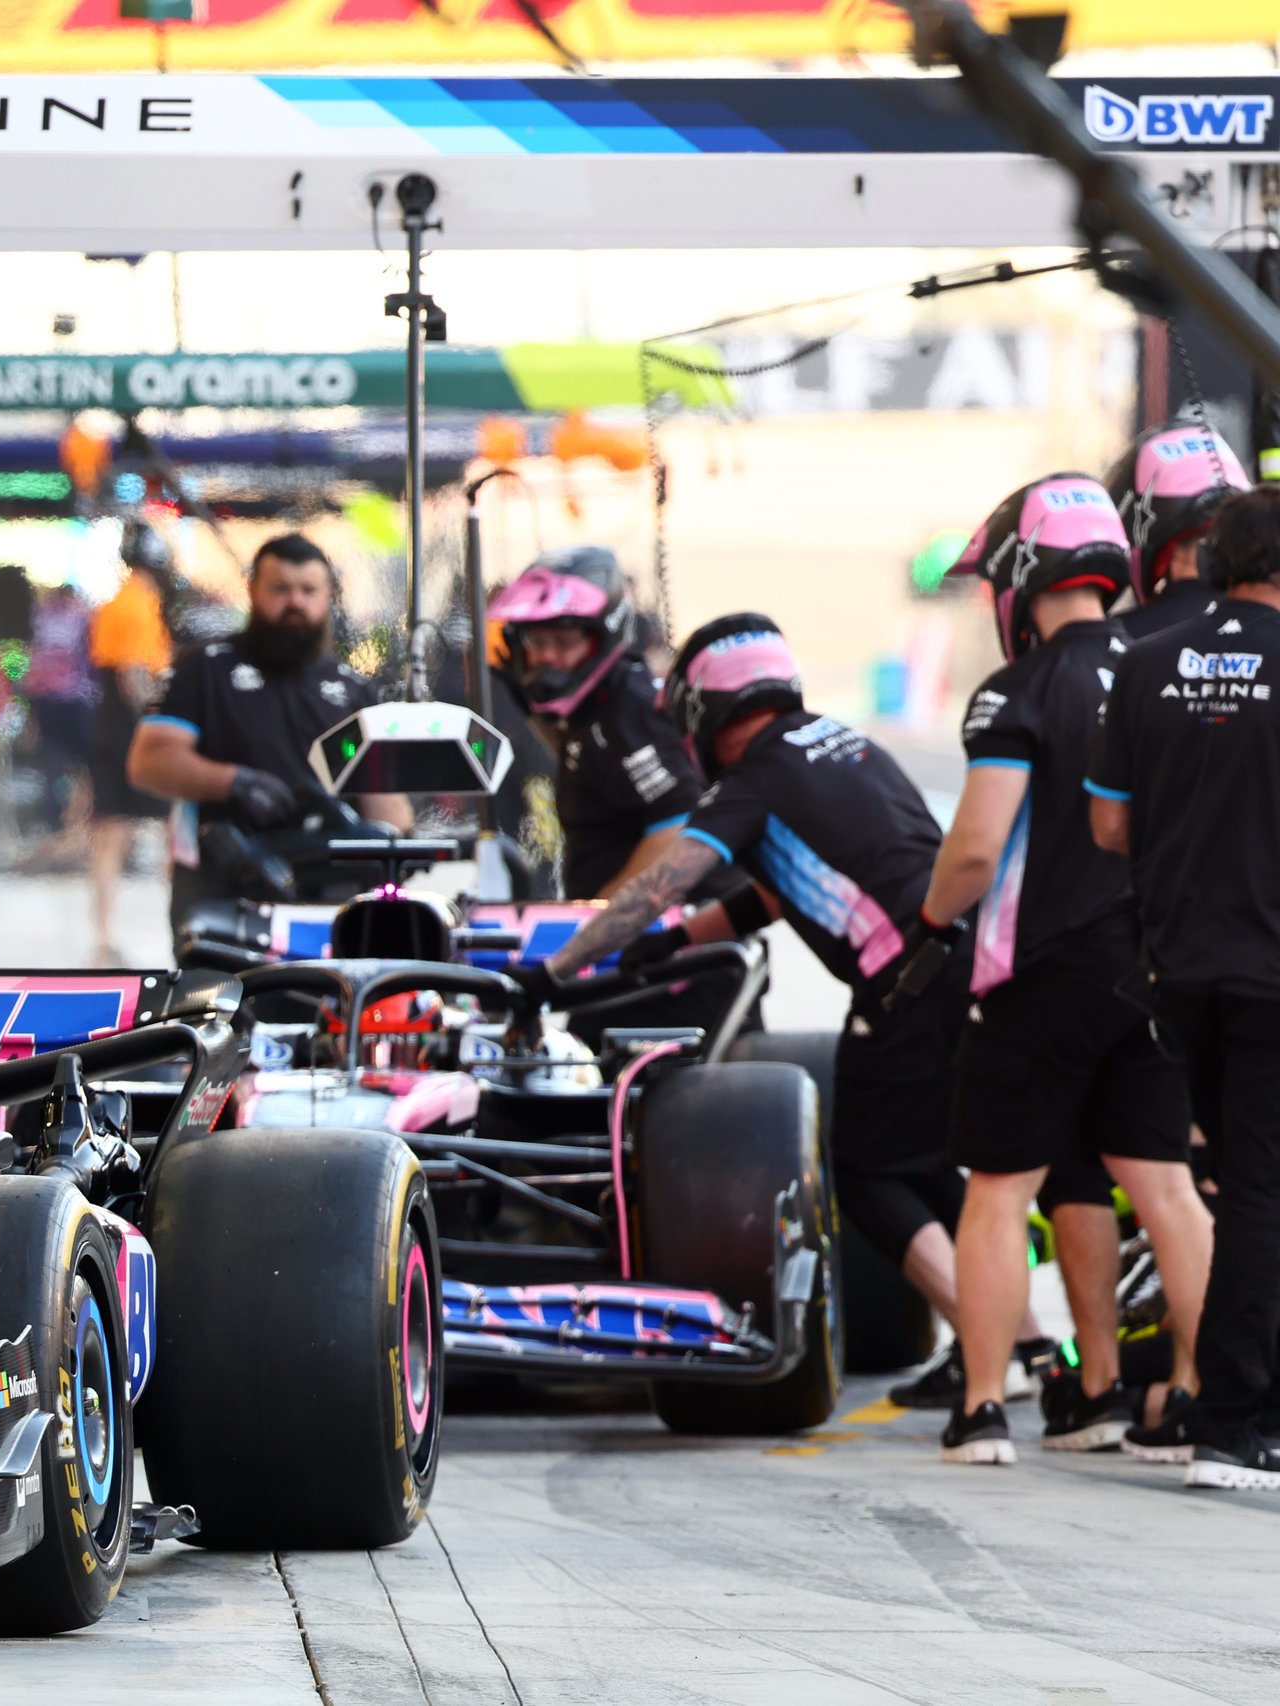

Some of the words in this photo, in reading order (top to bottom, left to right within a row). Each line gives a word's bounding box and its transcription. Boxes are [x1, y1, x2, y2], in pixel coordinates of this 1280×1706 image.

[1140, 97, 1272, 142] BWT
[127, 358, 357, 405] aramco
[1204, 653, 1263, 680] BWT
[1160, 682, 1271, 700] ALPINE
[9, 1369, 38, 1400] Microsoft
